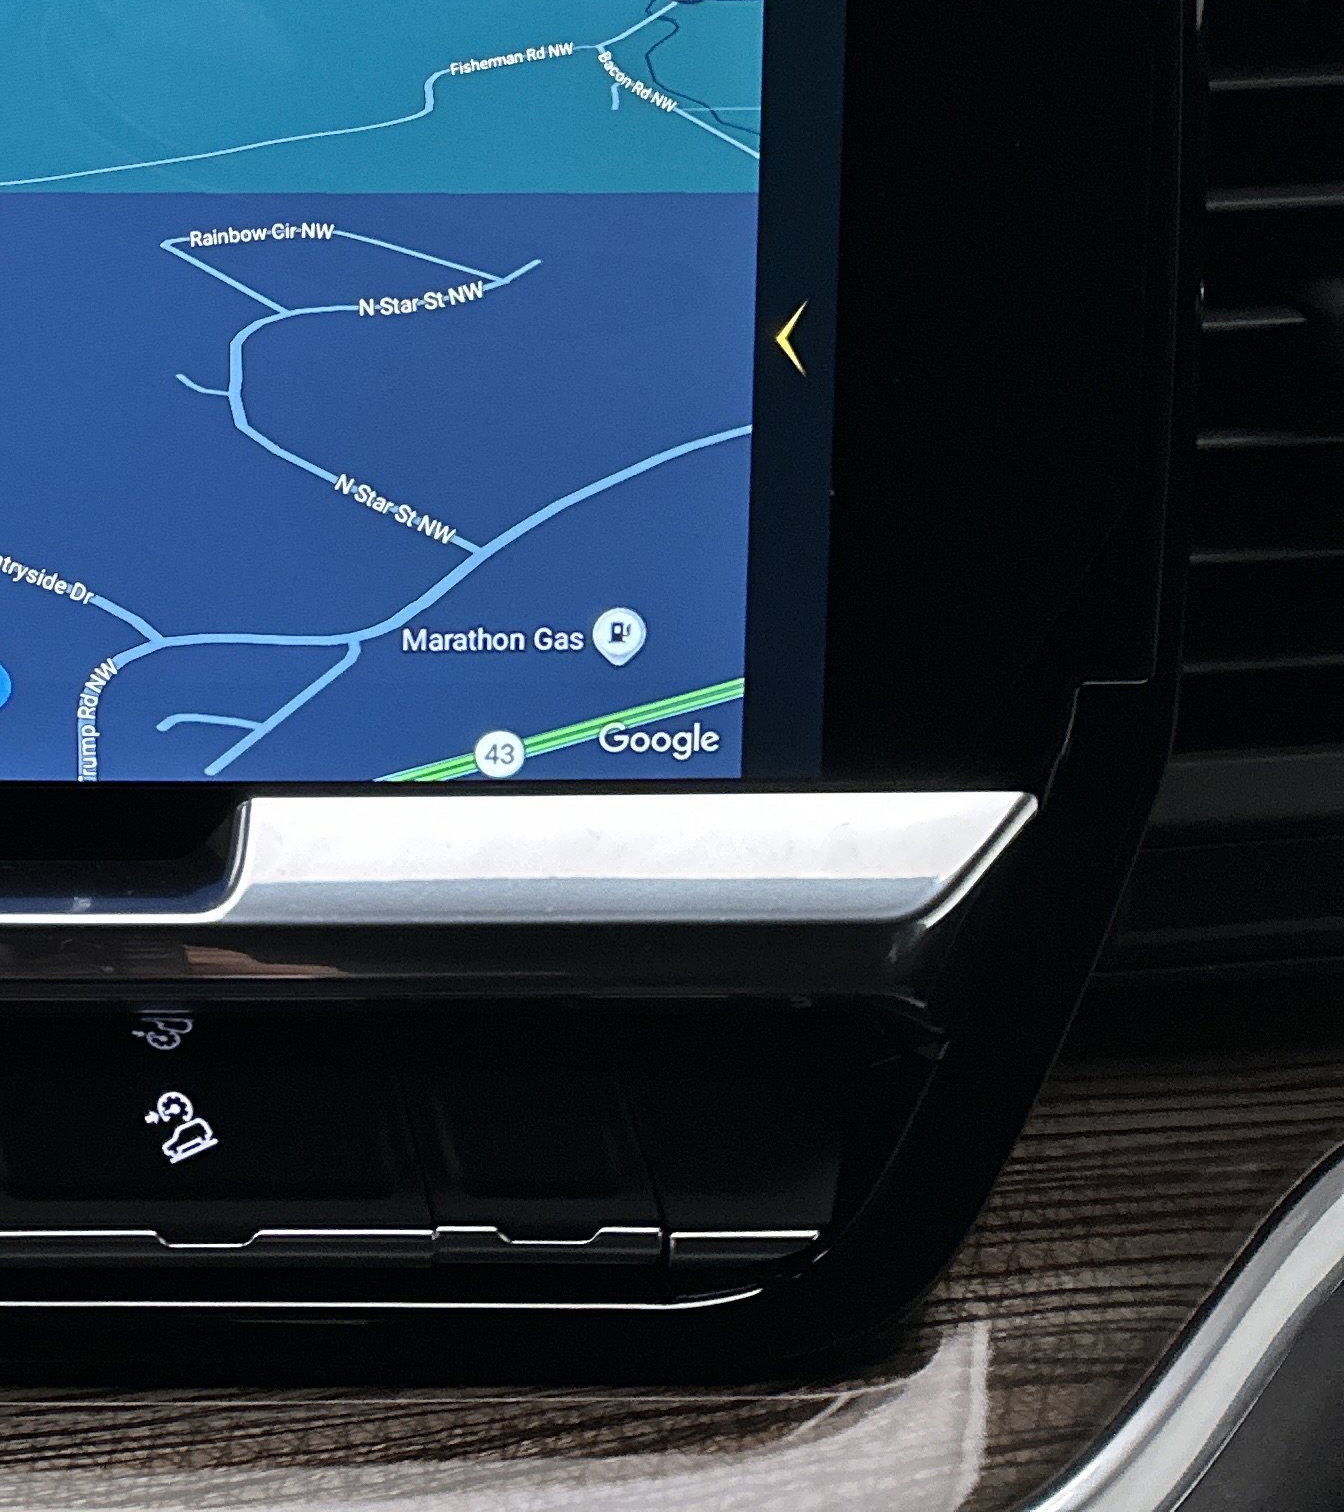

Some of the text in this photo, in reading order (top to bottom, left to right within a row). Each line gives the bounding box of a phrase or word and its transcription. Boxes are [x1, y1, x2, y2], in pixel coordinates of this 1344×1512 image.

[449, 41, 574, 76] Fisherman Rd NW
[598, 50, 678, 113] Bacon Rd NW
[189, 222, 335, 248] Rainbow Cir NW
[358, 280, 484, 317] N Star St NW
[334, 473, 458, 545] N Star St NW
[69, 581, 95, 605] Dr
[400, 625, 585, 652] Marathon Gas
[84, 657, 119, 694] NW
[77, 693, 99, 720] Rd
[483, 743, 515, 765] 43
[598, 721, 721, 761] Google
